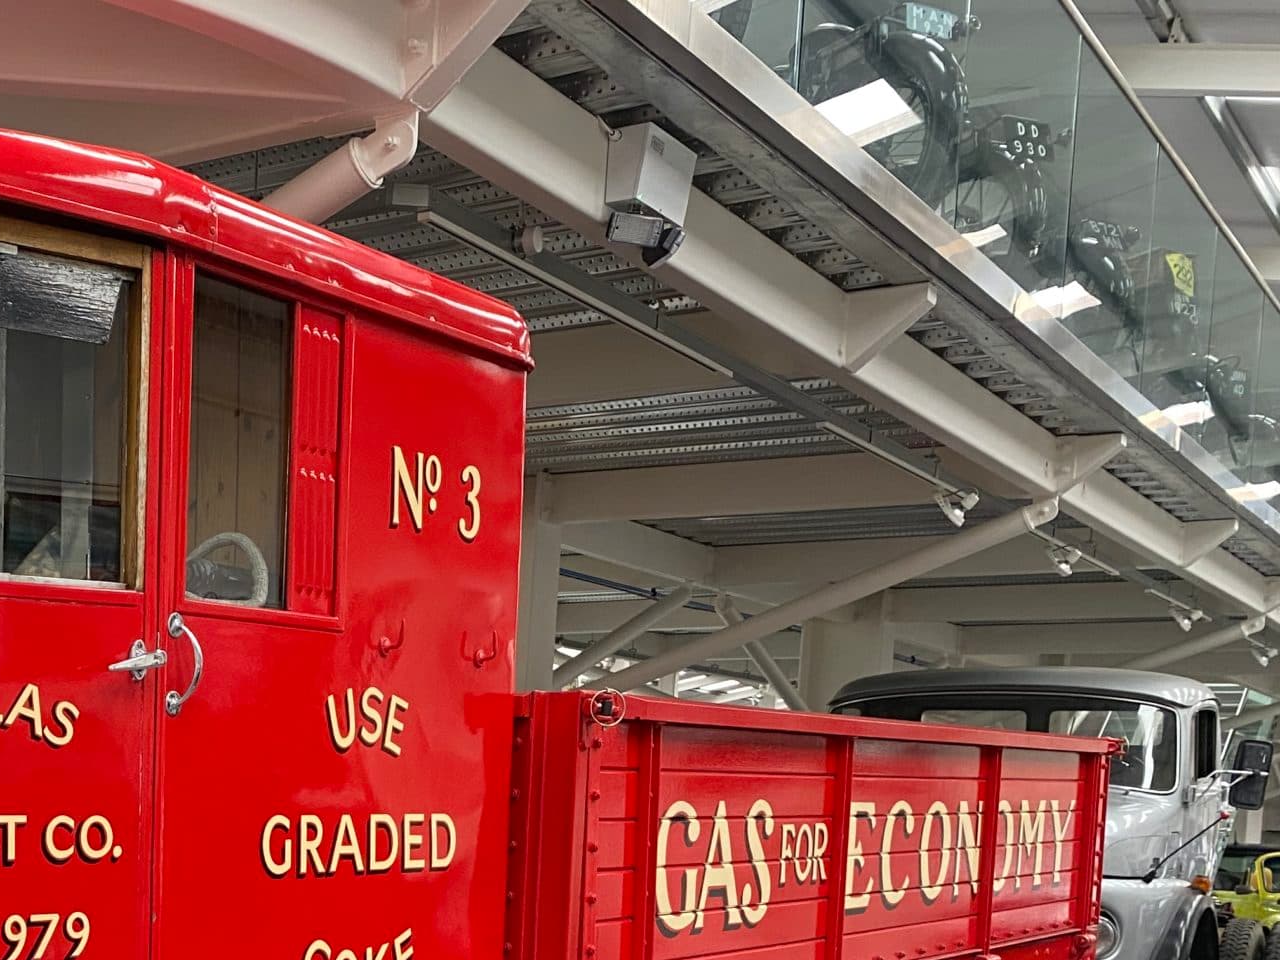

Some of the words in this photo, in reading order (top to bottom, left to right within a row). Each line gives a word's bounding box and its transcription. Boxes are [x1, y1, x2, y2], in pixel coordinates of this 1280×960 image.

[913, 5, 953, 26] MAN
[1014, 140, 1046, 157] 930
[457, 464, 482, 543] 3
[325, 686, 409, 757] USE
[41, 814, 124, 863] CO.
[261, 812, 457, 879] GRADED
[655, 798, 775, 938] GAS
[778, 822, 829, 888] FOR
